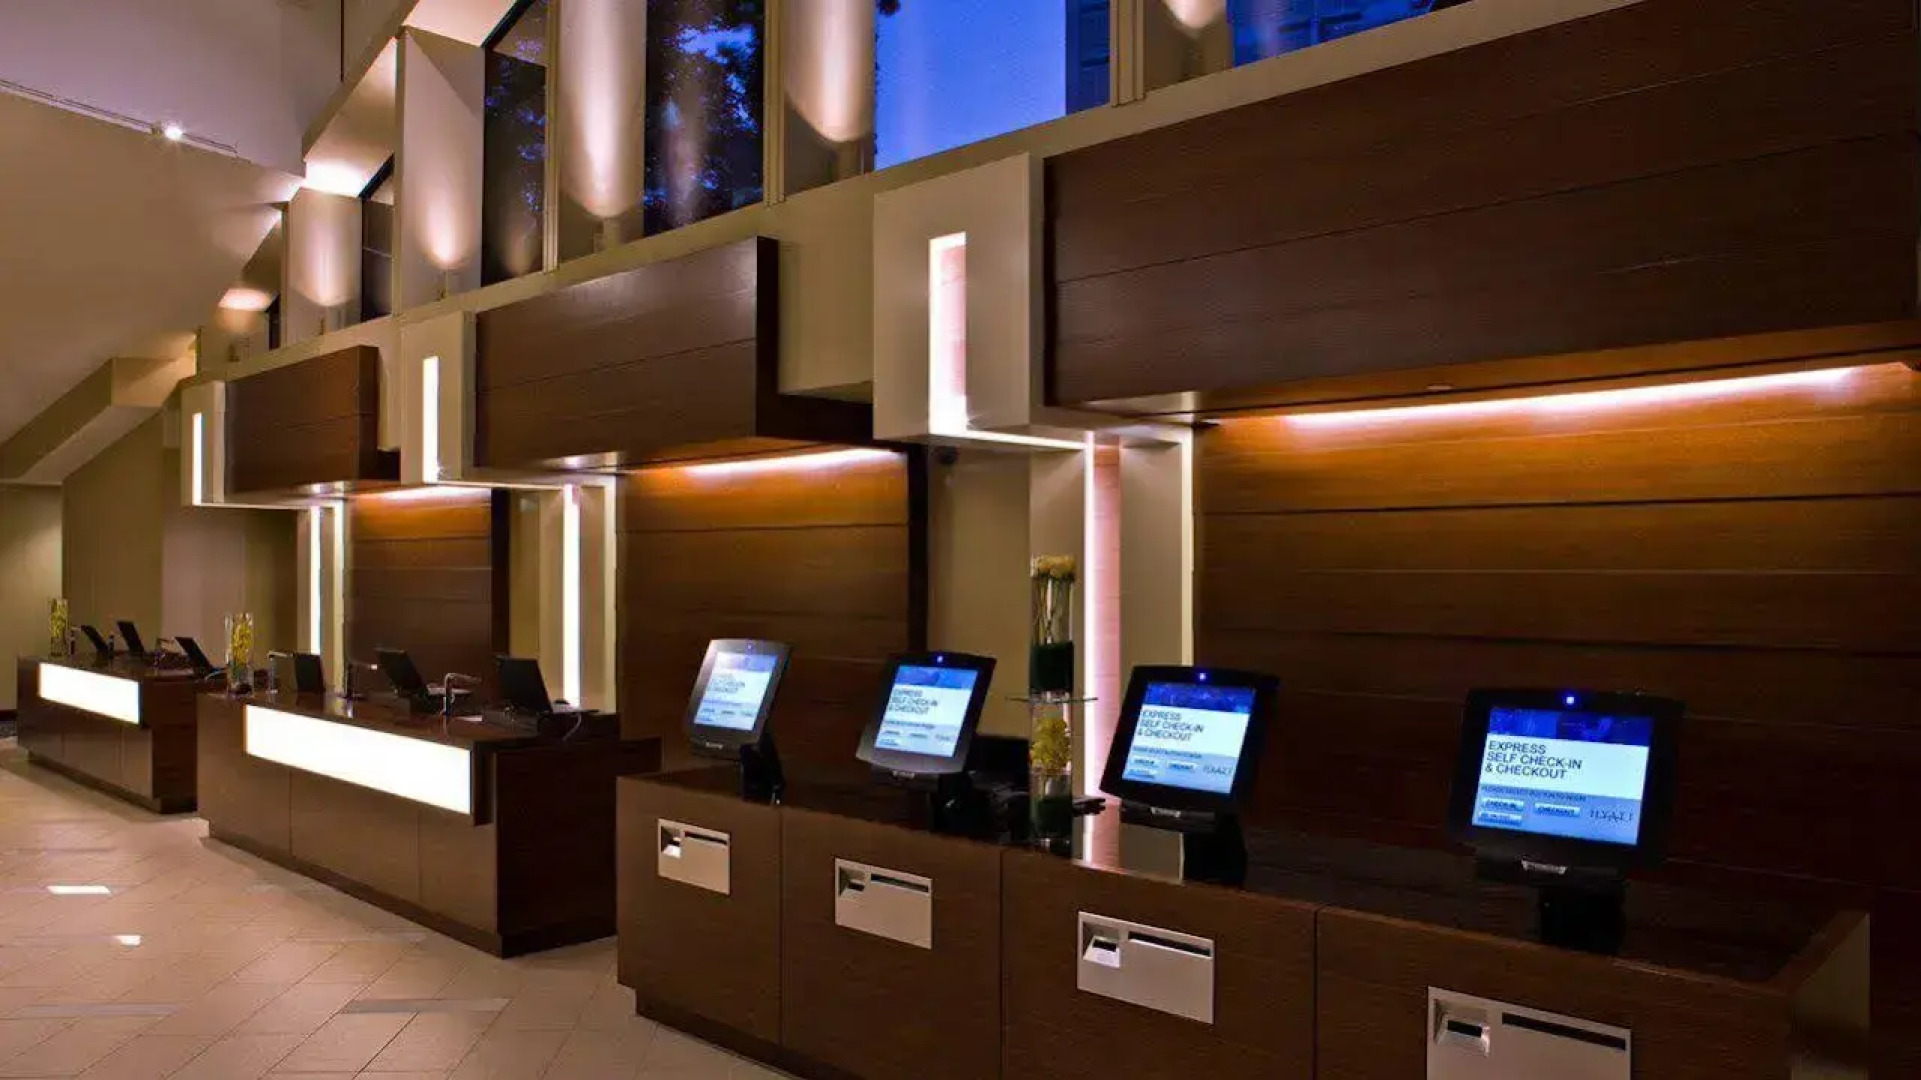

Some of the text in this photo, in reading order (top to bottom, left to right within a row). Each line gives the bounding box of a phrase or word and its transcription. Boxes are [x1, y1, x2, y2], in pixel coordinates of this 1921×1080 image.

[1143, 709, 1182, 722] EXPRESS
[1139, 718, 1204, 733] SELF CHECK-IN
[1144, 729, 1193, 741] CHECKOUT
[1488, 740, 1547, 755] EXPRESS
[1486, 751, 1583, 770] SELF CHECK-IN
[1485, 764, 1568, 779] & CHECKOUT
